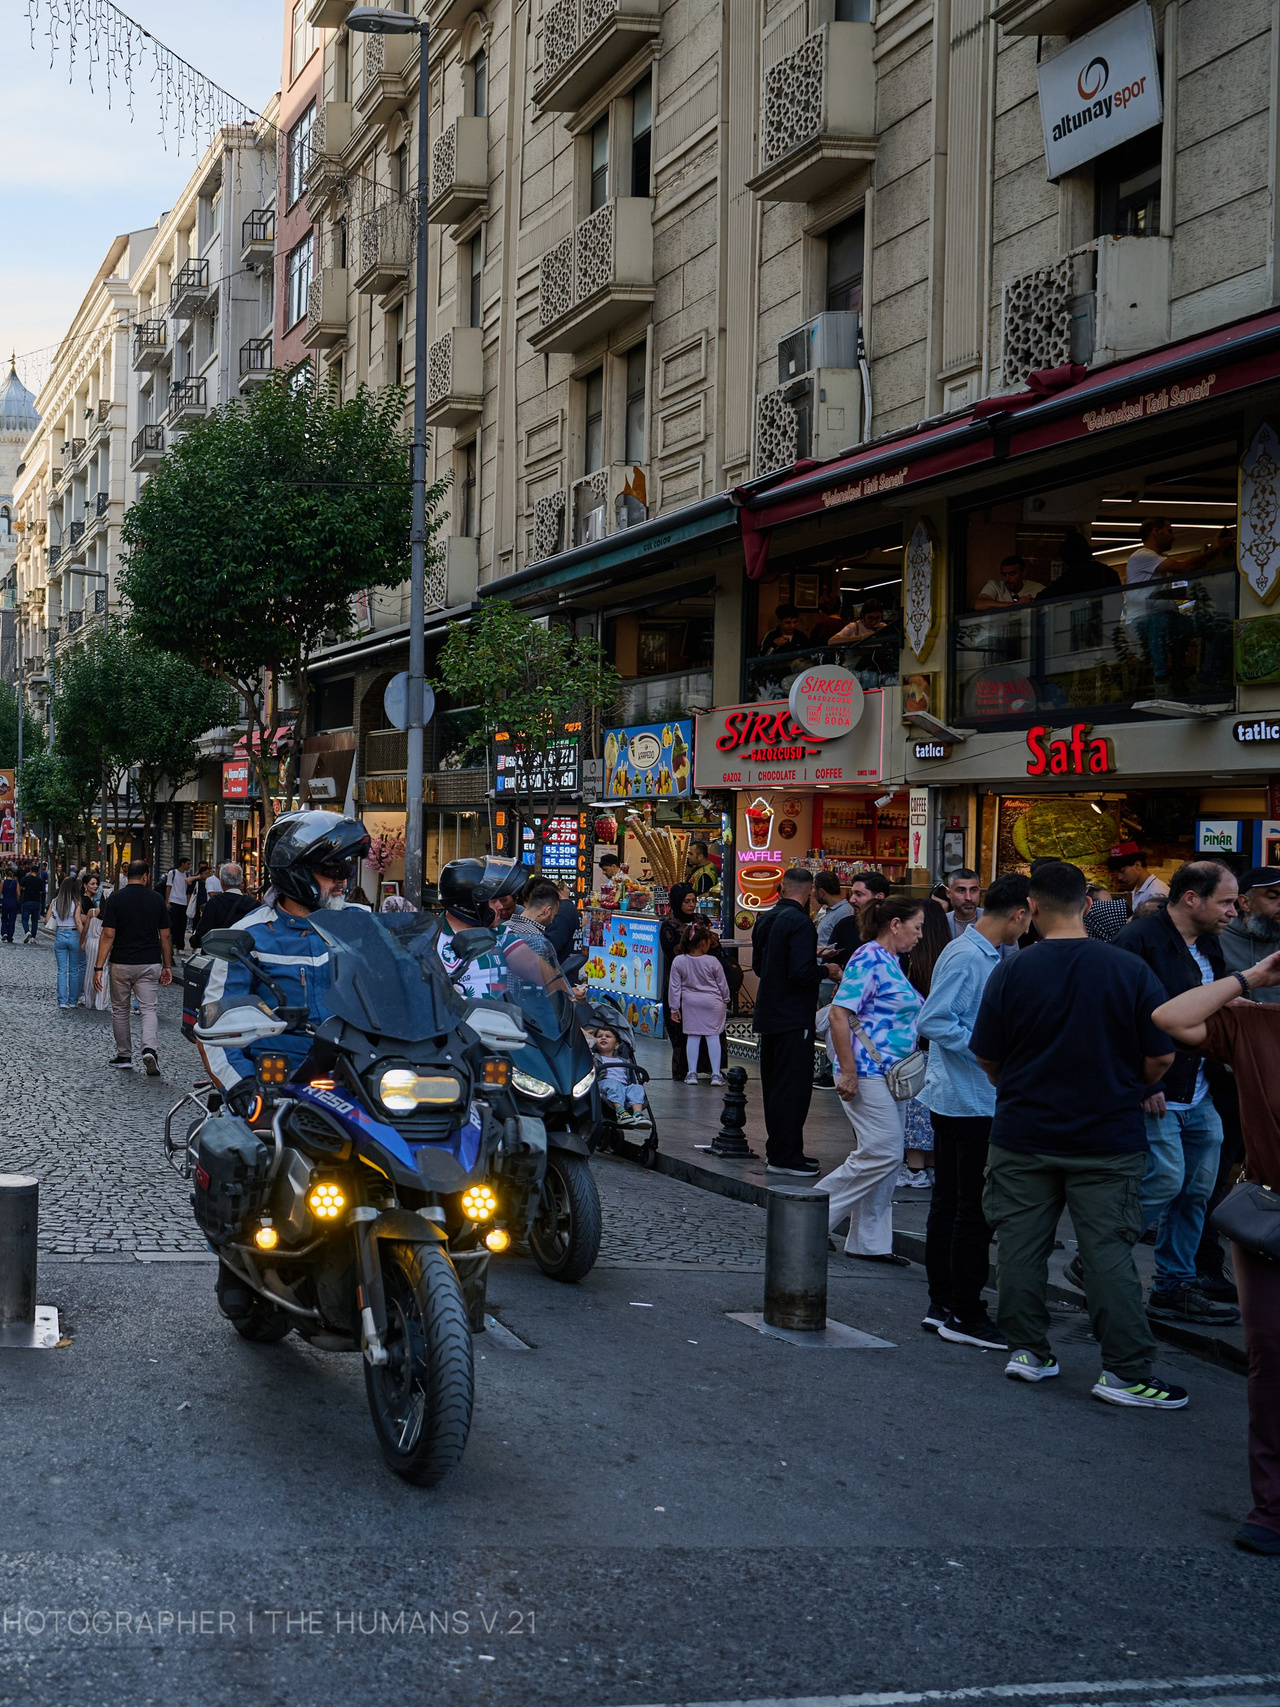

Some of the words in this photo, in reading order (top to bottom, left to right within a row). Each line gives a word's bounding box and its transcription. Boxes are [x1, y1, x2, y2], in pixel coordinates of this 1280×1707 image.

[1052, 76, 1147, 143] altunayspor
[801, 676, 854, 696] SİRKECİ
[808, 695, 852, 704] GAZOZCUSU
[825, 717, 851, 726] SODA
[716, 710, 820, 751] SİRK
[751, 746, 803, 761] GAZOZCUSU
[915, 743, 944, 758] tatlıcı
[1026, 723, 1111, 775] Safa
[723, 772, 741, 783] GAZOZ
[758, 770, 796, 781] CHOCOLATE
[815, 768, 843, 779] COFFEE
[545, 846, 576, 854] 55.500
[737, 851, 782, 861] WAFFLE
[545, 858, 576, 866] 55.950
[577, 812, 587, 914] EXCHA
